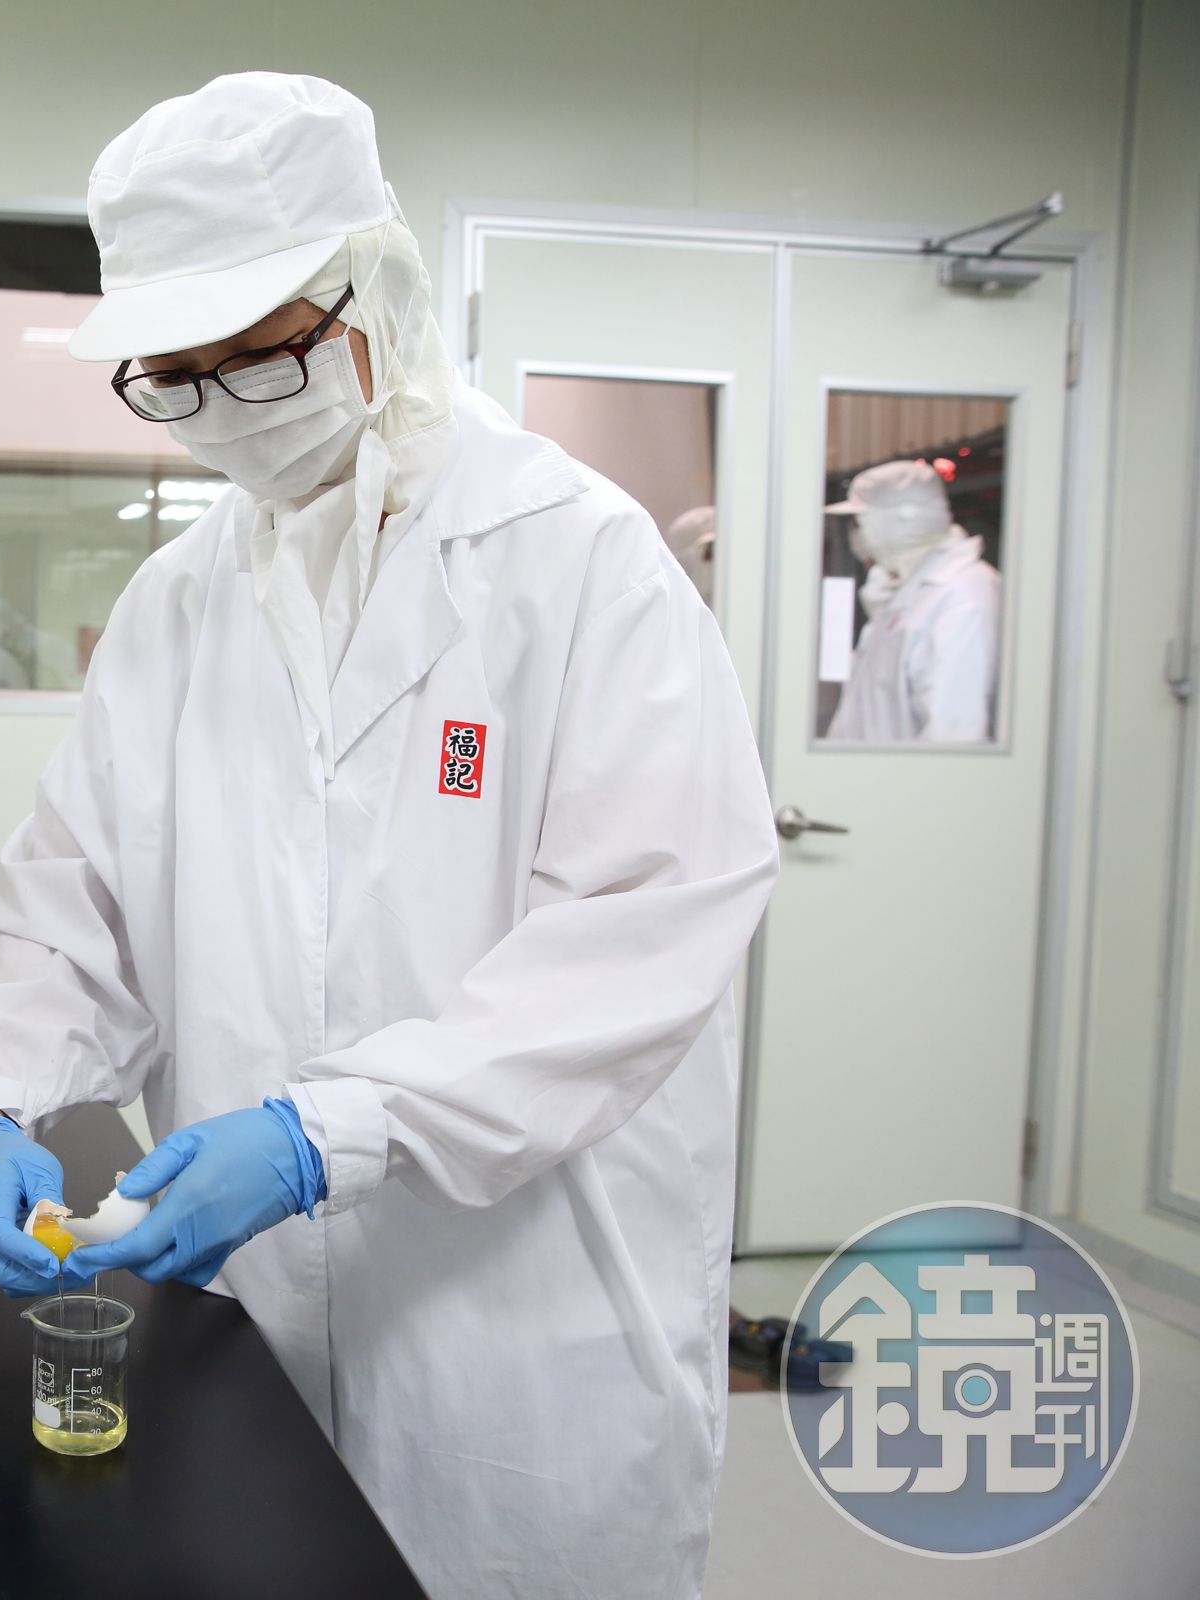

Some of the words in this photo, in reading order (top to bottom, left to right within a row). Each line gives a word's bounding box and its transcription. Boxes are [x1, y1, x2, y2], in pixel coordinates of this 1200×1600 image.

[445, 727, 479, 792] 福記
[91, 1367, 102, 1377] 80
[91, 1386, 102, 1395] 60
[91, 1407, 102, 1416] 40
